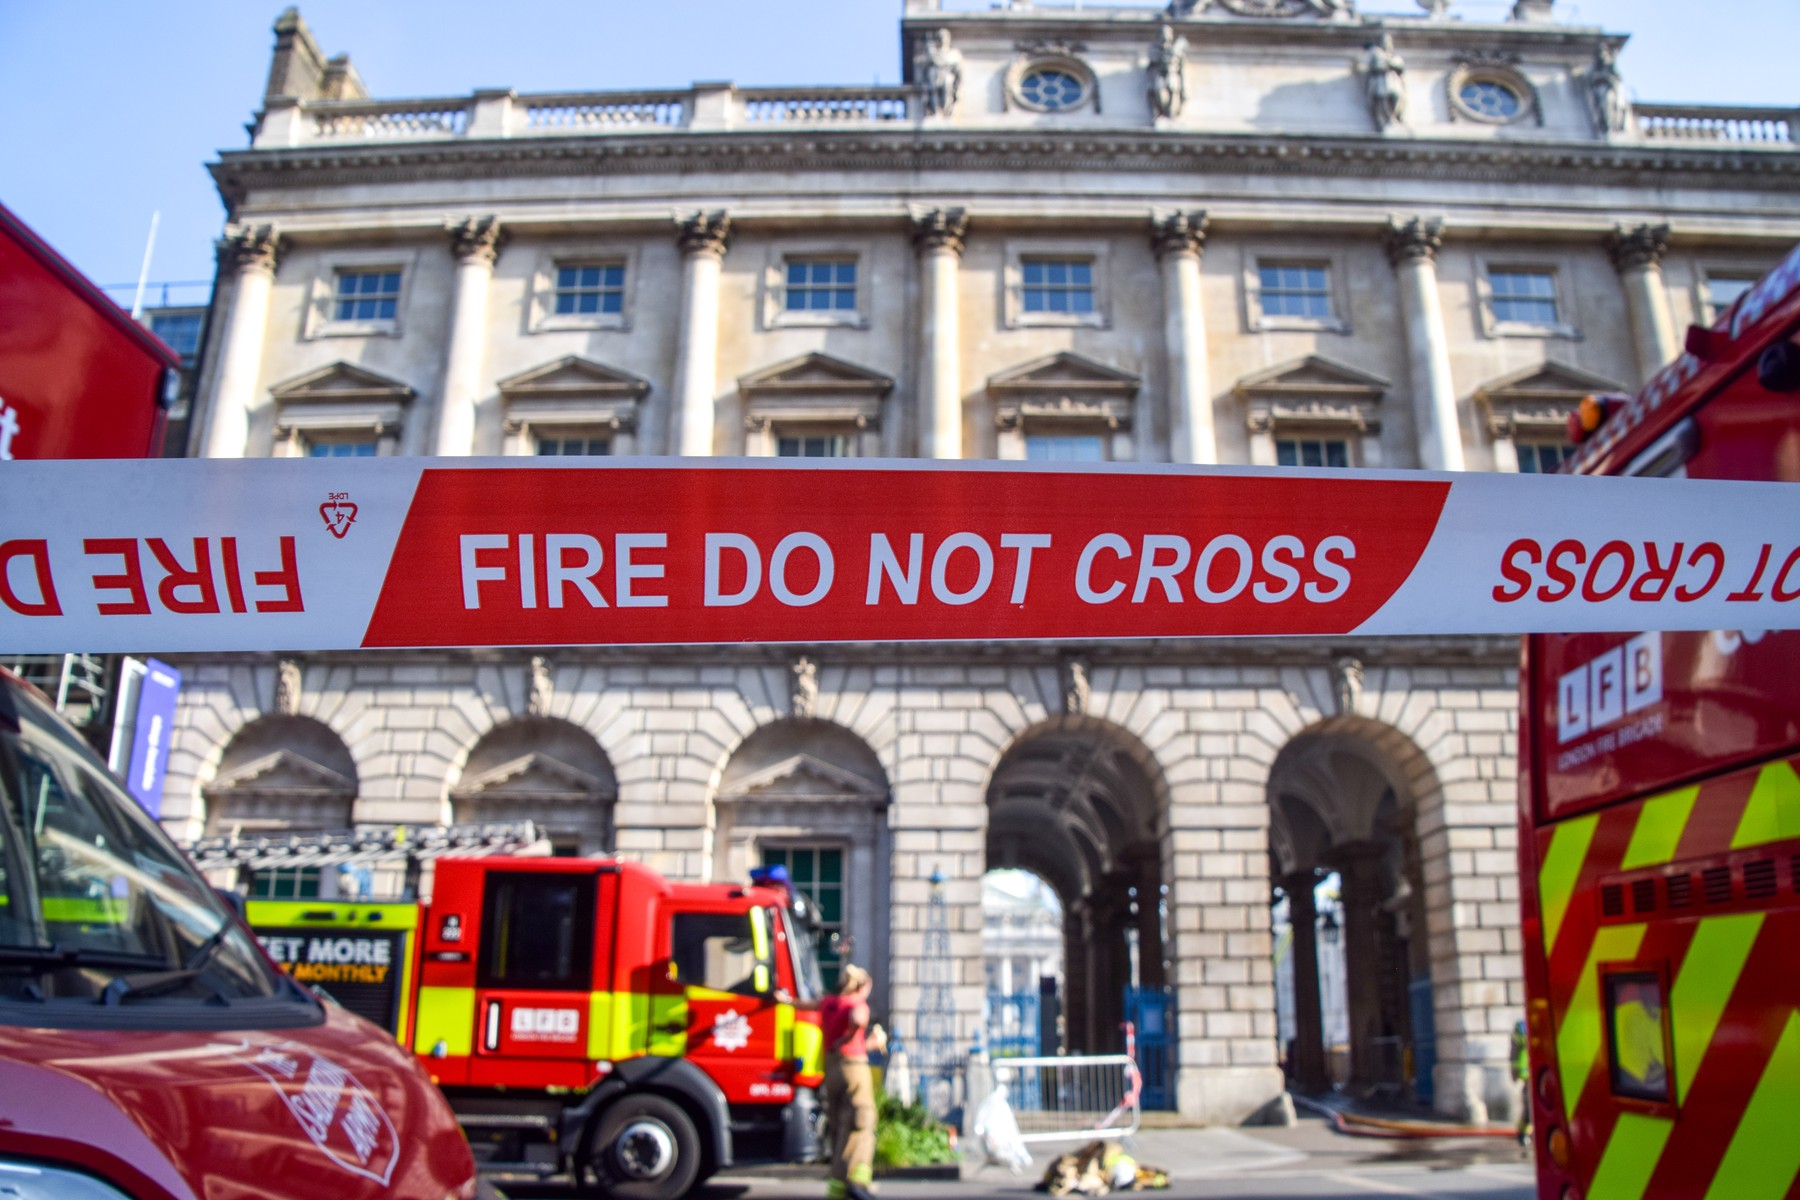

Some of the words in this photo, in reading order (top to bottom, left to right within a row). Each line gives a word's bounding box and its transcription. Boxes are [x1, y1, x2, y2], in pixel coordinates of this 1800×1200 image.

[328, 492, 349, 500] LDPE
[335, 511, 345, 524] 4
[84, 536, 304, 615] FIRE
[459, 532, 669, 609] FIRE
[704, 531, 835, 607] DO
[865, 531, 1052, 606] NOT
[1075, 533, 1357, 604] CROSS
[1492, 538, 1726, 603] CROSS
[1564, 643, 1655, 727] LFB
[293, 962, 389, 983] MONTHLY
[308, 937, 391, 964] MORE
